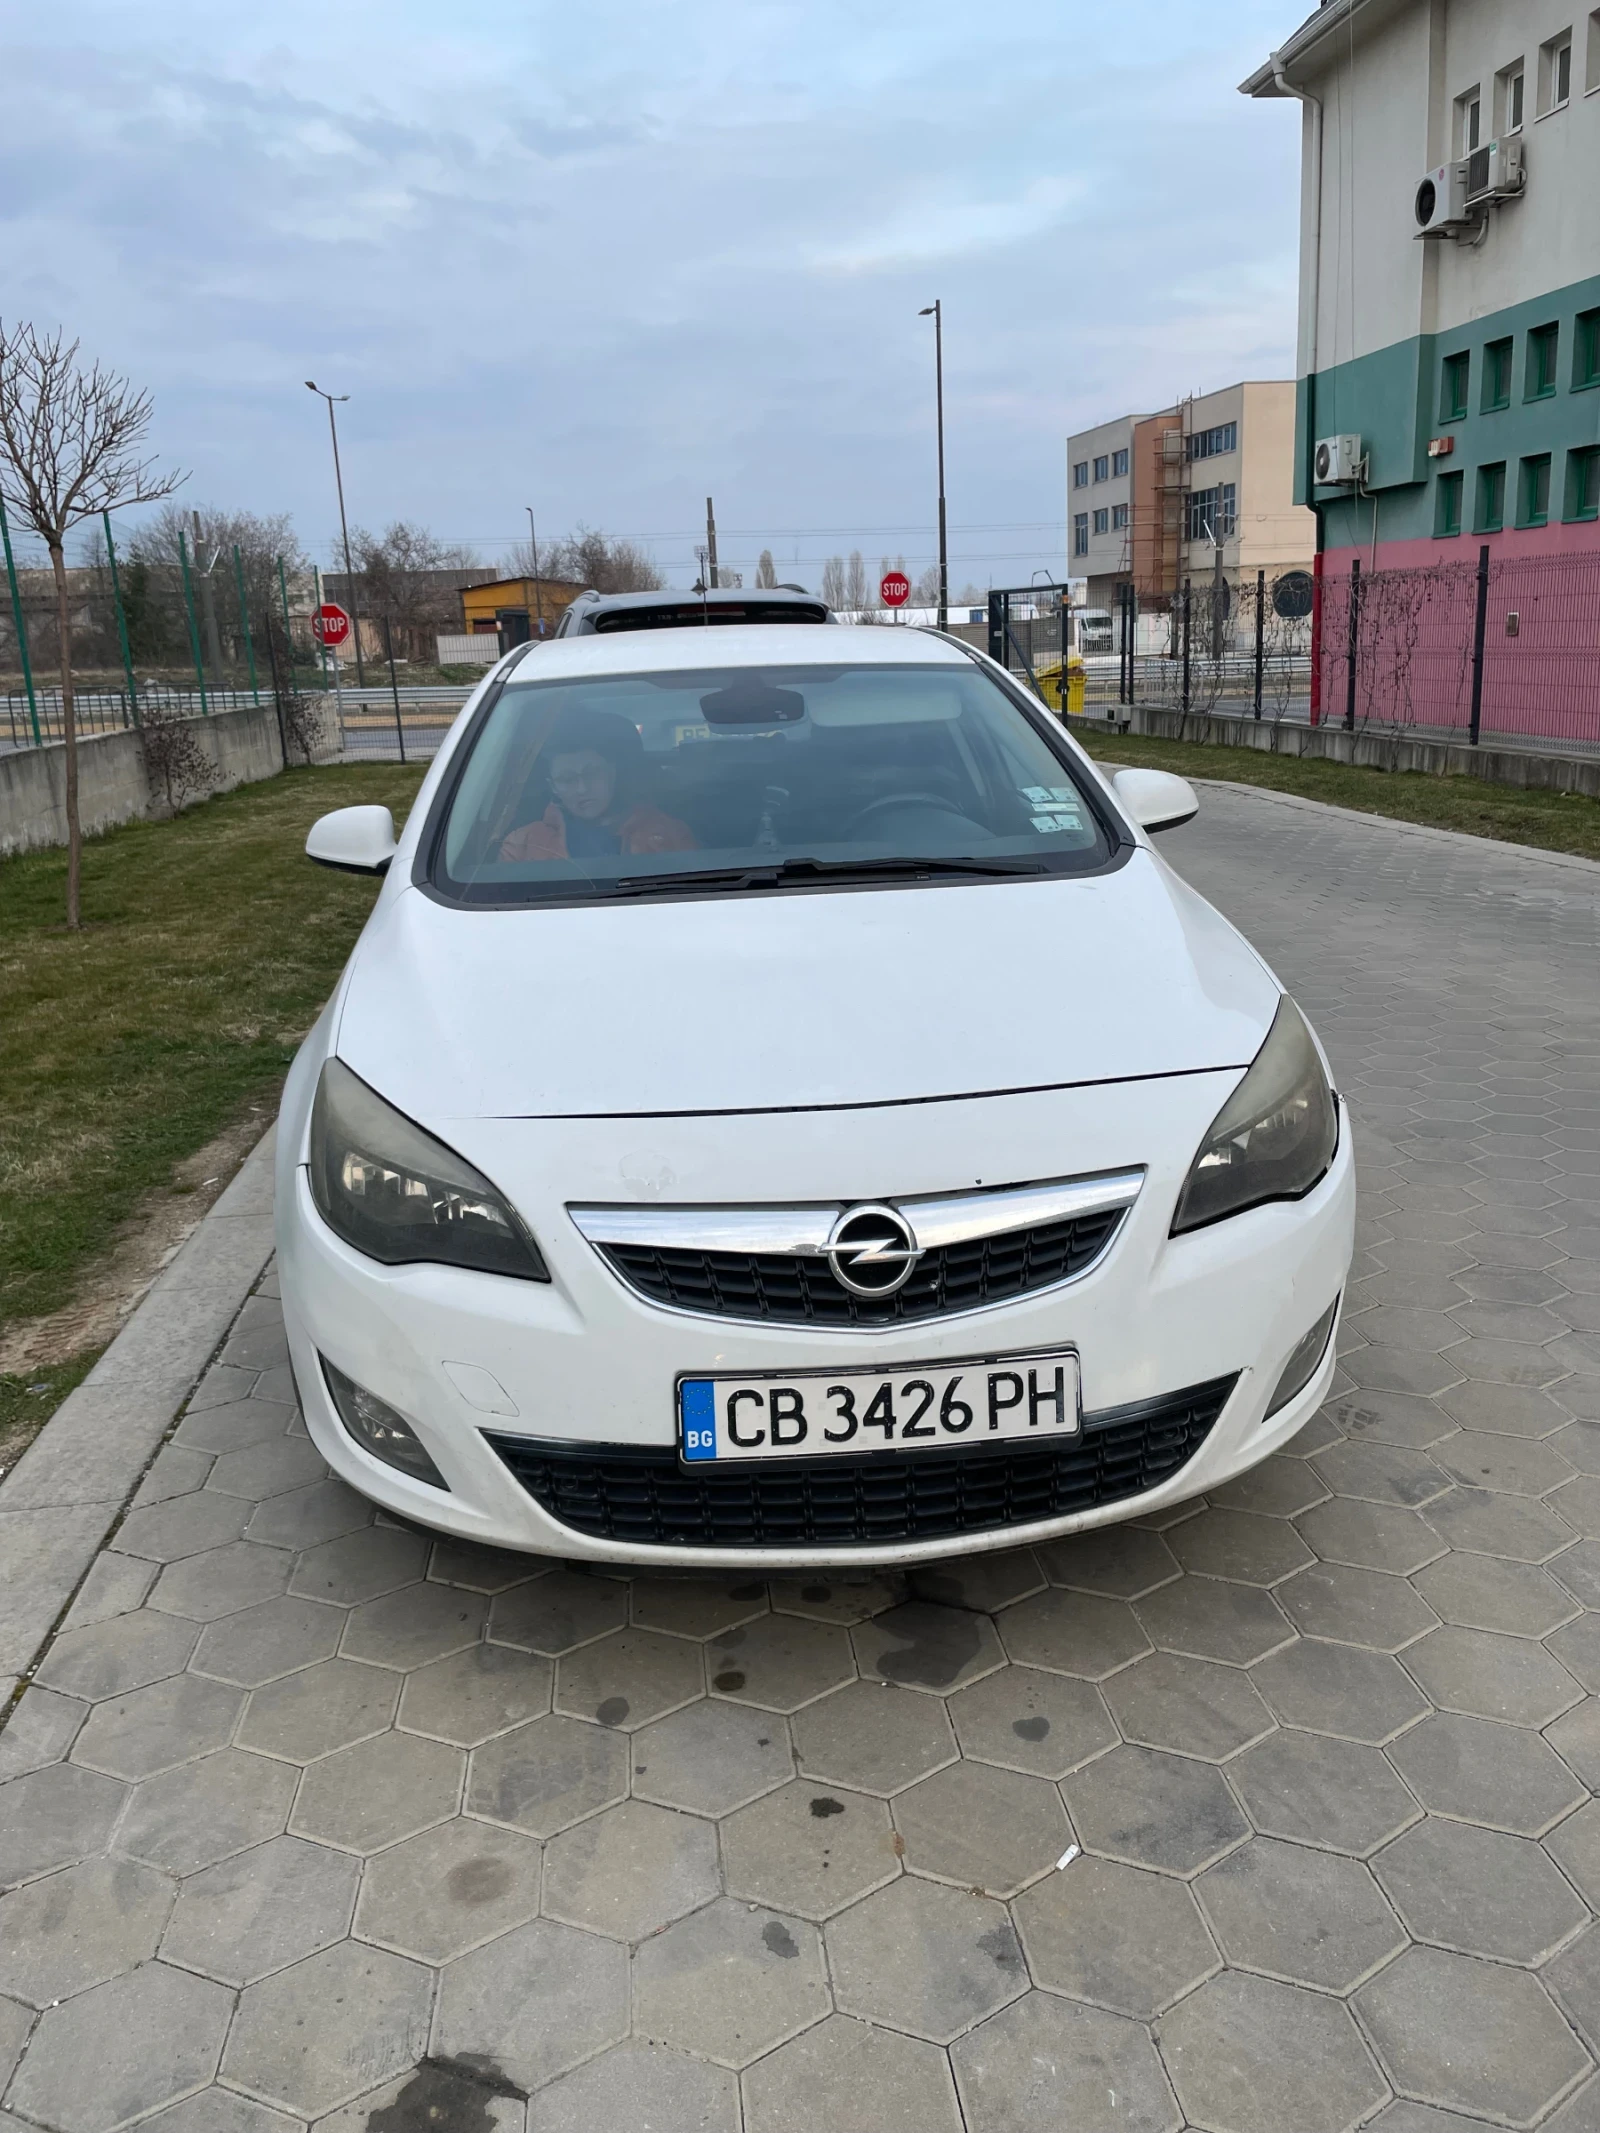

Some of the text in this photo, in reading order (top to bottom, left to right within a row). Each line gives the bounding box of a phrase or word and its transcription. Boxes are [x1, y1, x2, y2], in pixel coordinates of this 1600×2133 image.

[883, 583, 907, 596] STOP
[727, 1367, 1065, 1447] CB 3426 PH
[687, 1430, 713, 1448] BG
